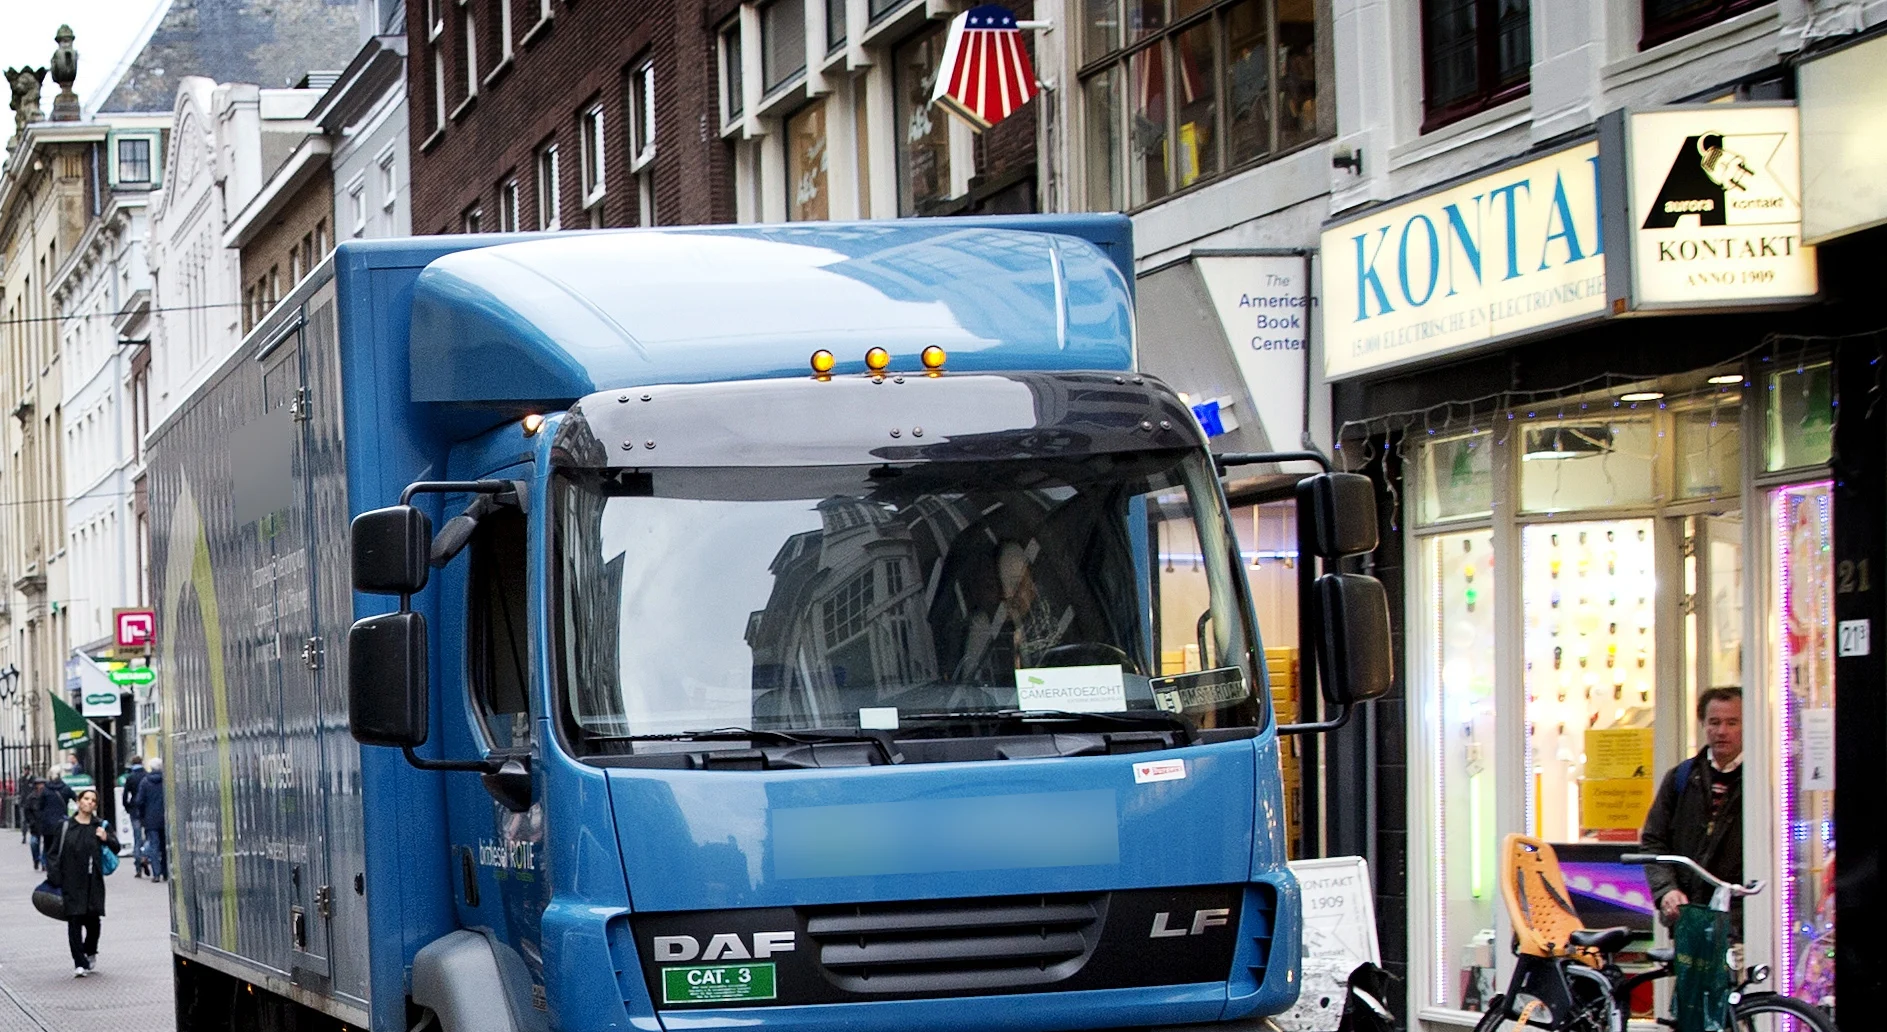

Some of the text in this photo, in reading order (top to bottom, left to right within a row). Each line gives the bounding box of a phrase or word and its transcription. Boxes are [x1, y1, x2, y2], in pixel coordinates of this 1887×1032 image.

[1664, 199, 1715, 213] aurora
[1657, 236, 1798, 262] KONTAKT
[1265, 274, 1291, 287] The
[1687, 269, 1775, 287] ANNO 1909
[1239, 293, 1319, 308] American
[1257, 314, 1300, 329] Book
[1838, 559, 1870, 594] 21
[1020, 685, 1121, 700] CAMERATOEZICHT
[1304, 876, 1354, 890] ONTAKT
[1311, 895, 1344, 909] 1909
[1150, 908, 1230, 938] LF
[653, 931, 795, 961] DAF
[687, 968, 752, 985] CAT. 3
